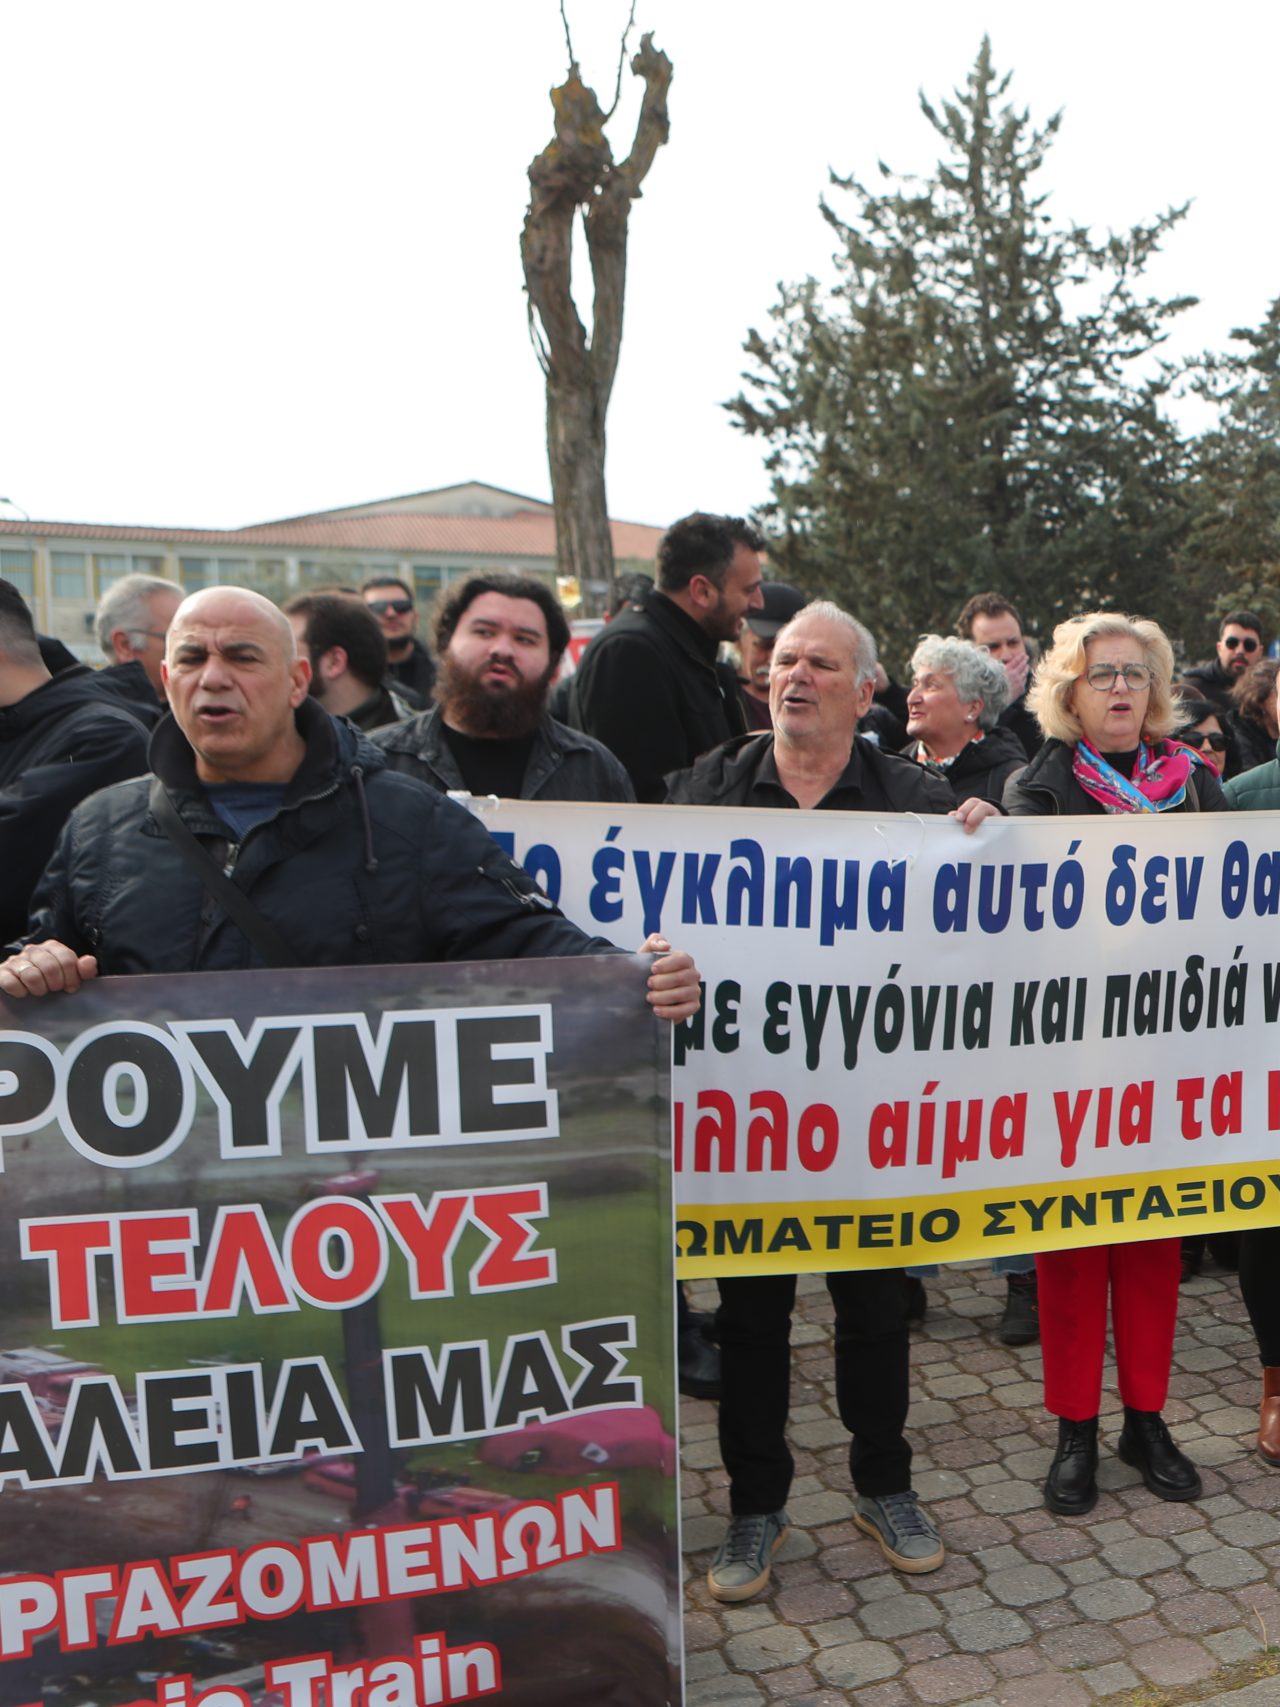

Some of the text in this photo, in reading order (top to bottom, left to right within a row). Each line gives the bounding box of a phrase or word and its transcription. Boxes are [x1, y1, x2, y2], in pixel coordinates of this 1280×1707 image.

[588, 825, 906, 947] έγκλημα
[932, 839, 1086, 935] αυτό
[1104, 845, 1204, 926] δεν
[763, 963, 991, 1072] εγγόνια
[1009, 976, 1088, 1047] και
[1102, 945, 1248, 1039] παιδιά
[868, 1080, 1028, 1179] αίμα
[1053, 1080, 1155, 1168] για
[1176, 1071, 1244, 1141] τα
[20, 1182, 557, 1330] ΤΕΛΟΥΣ
[382, 1315, 644, 1448] ΜΑΣ
[0, 1482, 622, 1659] ΡΓΑΖΟΜΕΝΩΝ
[265, 1632, 502, 1707] Train
